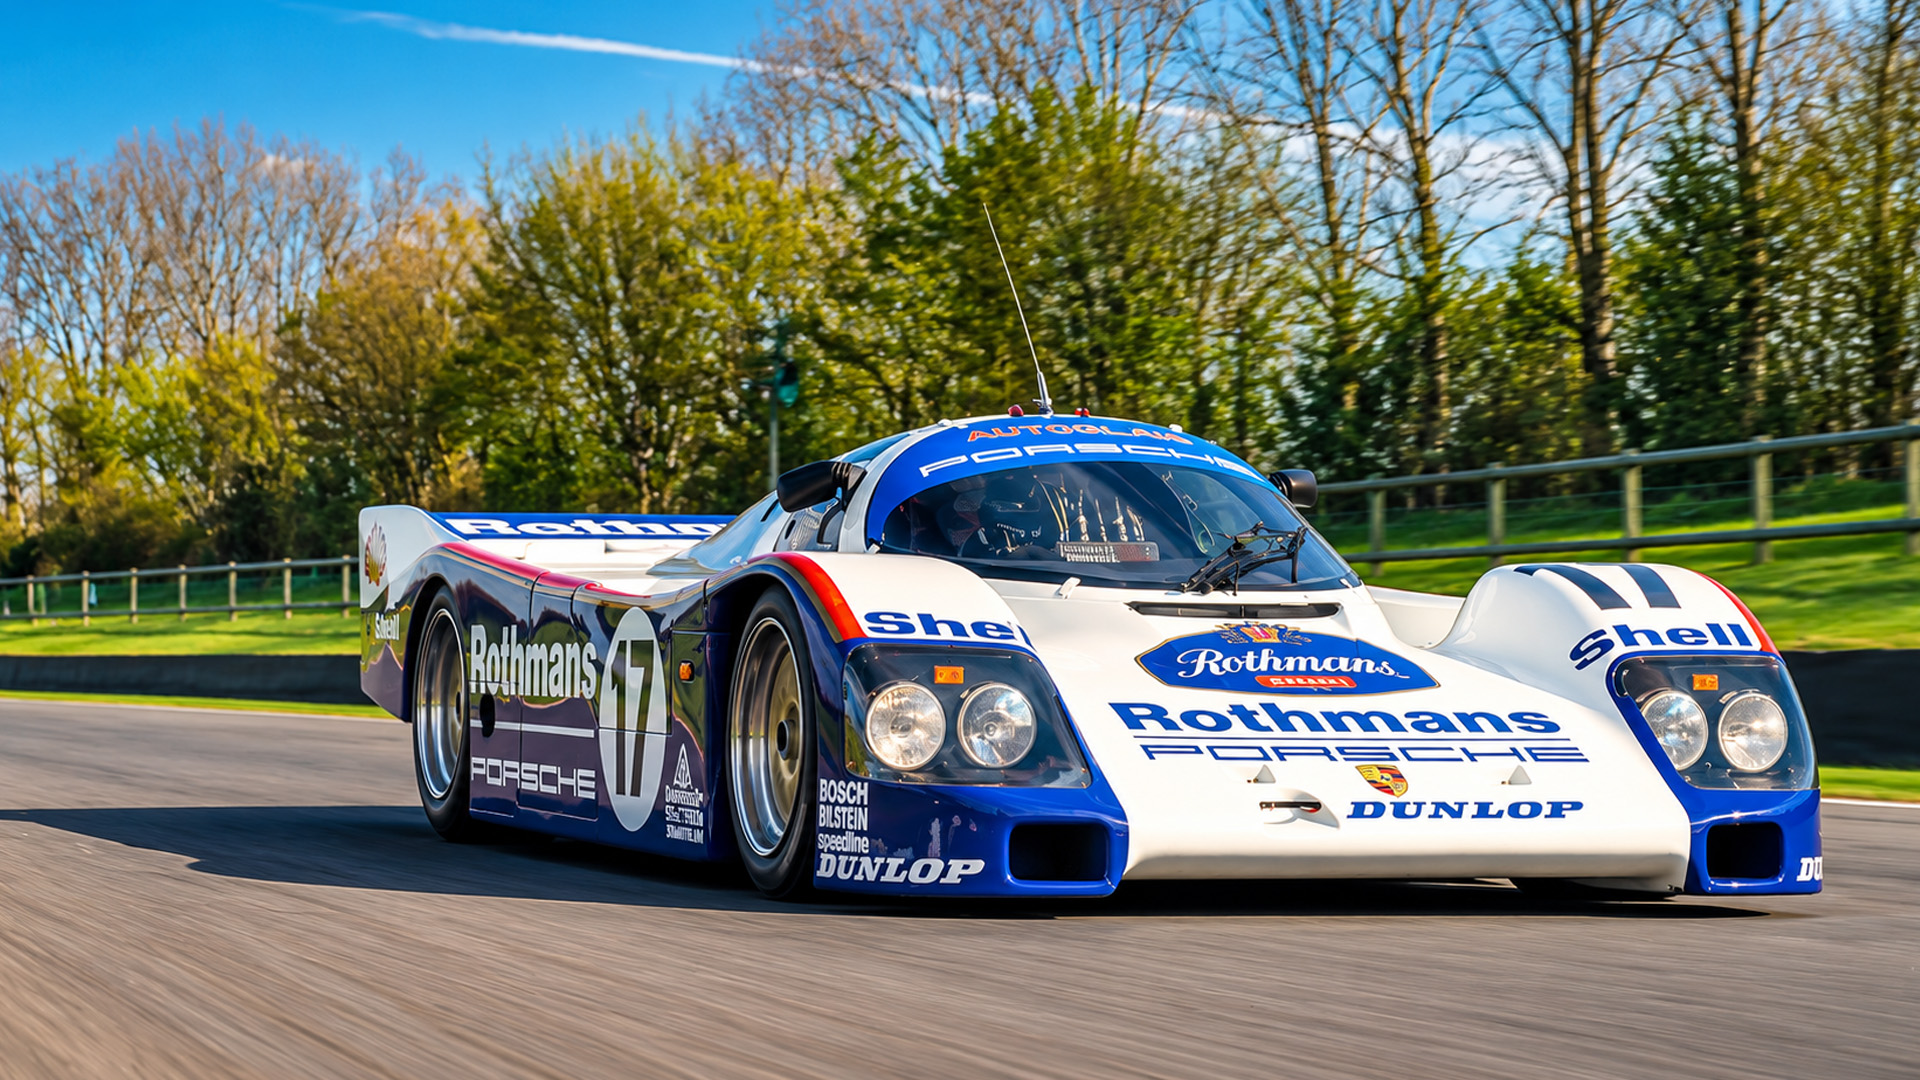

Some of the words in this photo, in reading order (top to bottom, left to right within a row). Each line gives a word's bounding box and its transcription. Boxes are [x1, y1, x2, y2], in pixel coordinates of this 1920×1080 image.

[471, 624, 597, 699] Rothmans
[1569, 623, 1753, 670] Shell
[1176, 648, 1411, 678] Rothmans
[610, 640, 654, 797] 17
[1108, 702, 1561, 734] Rothmans
[1140, 744, 1590, 763] PORSCHE
[471, 757, 596, 799] PORSCHE
[819, 778, 869, 805] BOSCH
[819, 804, 869, 831] BILSTEIN
[1346, 801, 1584, 819] DUNLOP
[817, 830, 870, 854] speedline
[816, 853, 986, 884] DUNLOP
